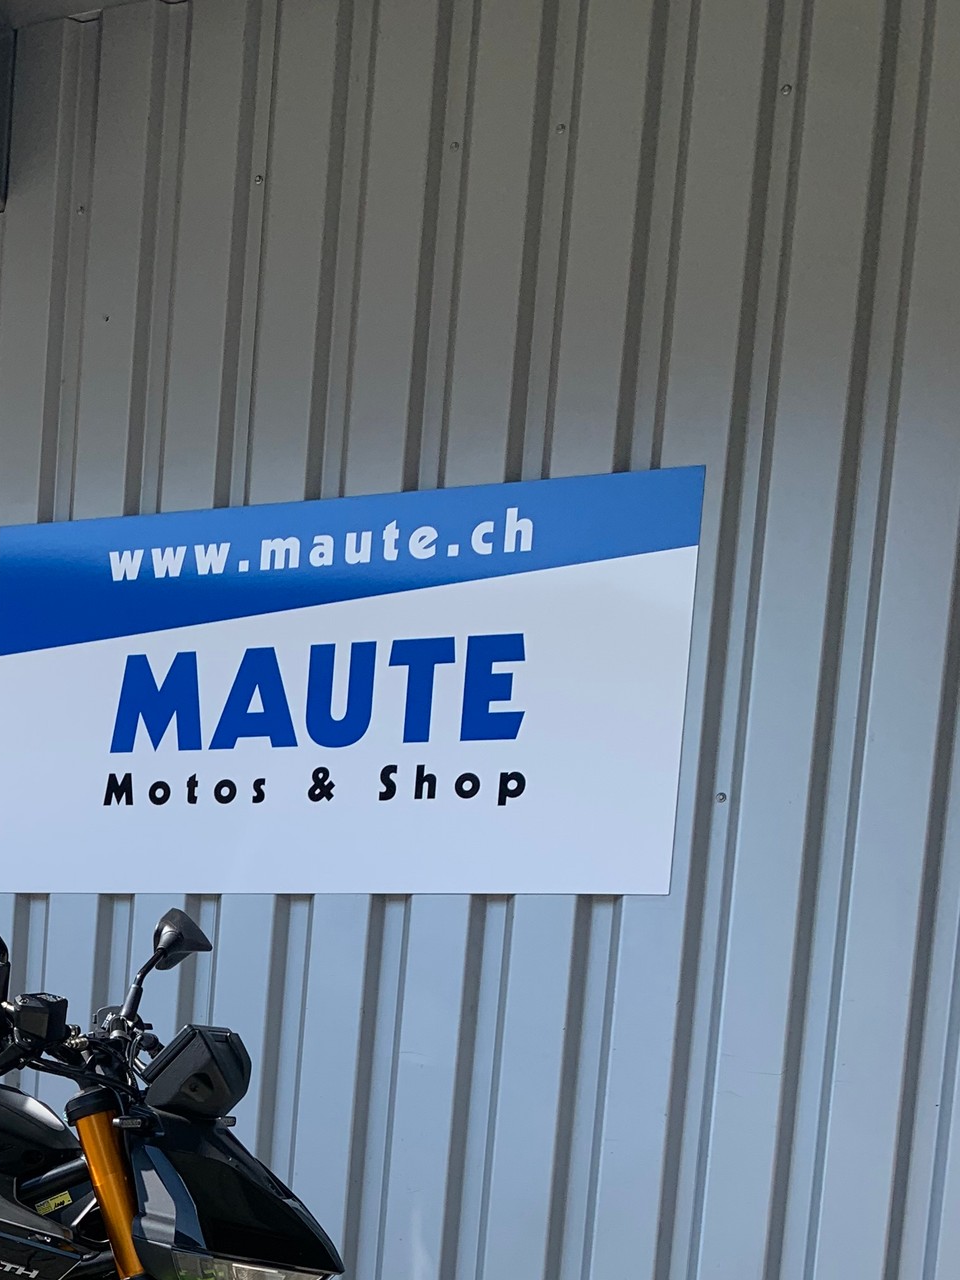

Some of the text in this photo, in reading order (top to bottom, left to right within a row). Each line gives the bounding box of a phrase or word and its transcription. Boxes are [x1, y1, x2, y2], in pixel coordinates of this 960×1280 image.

[108, 507, 534, 582] www.maute.ch
[109, 633, 527, 753] MAUTE
[103, 763, 527, 806] Motos & Shop
